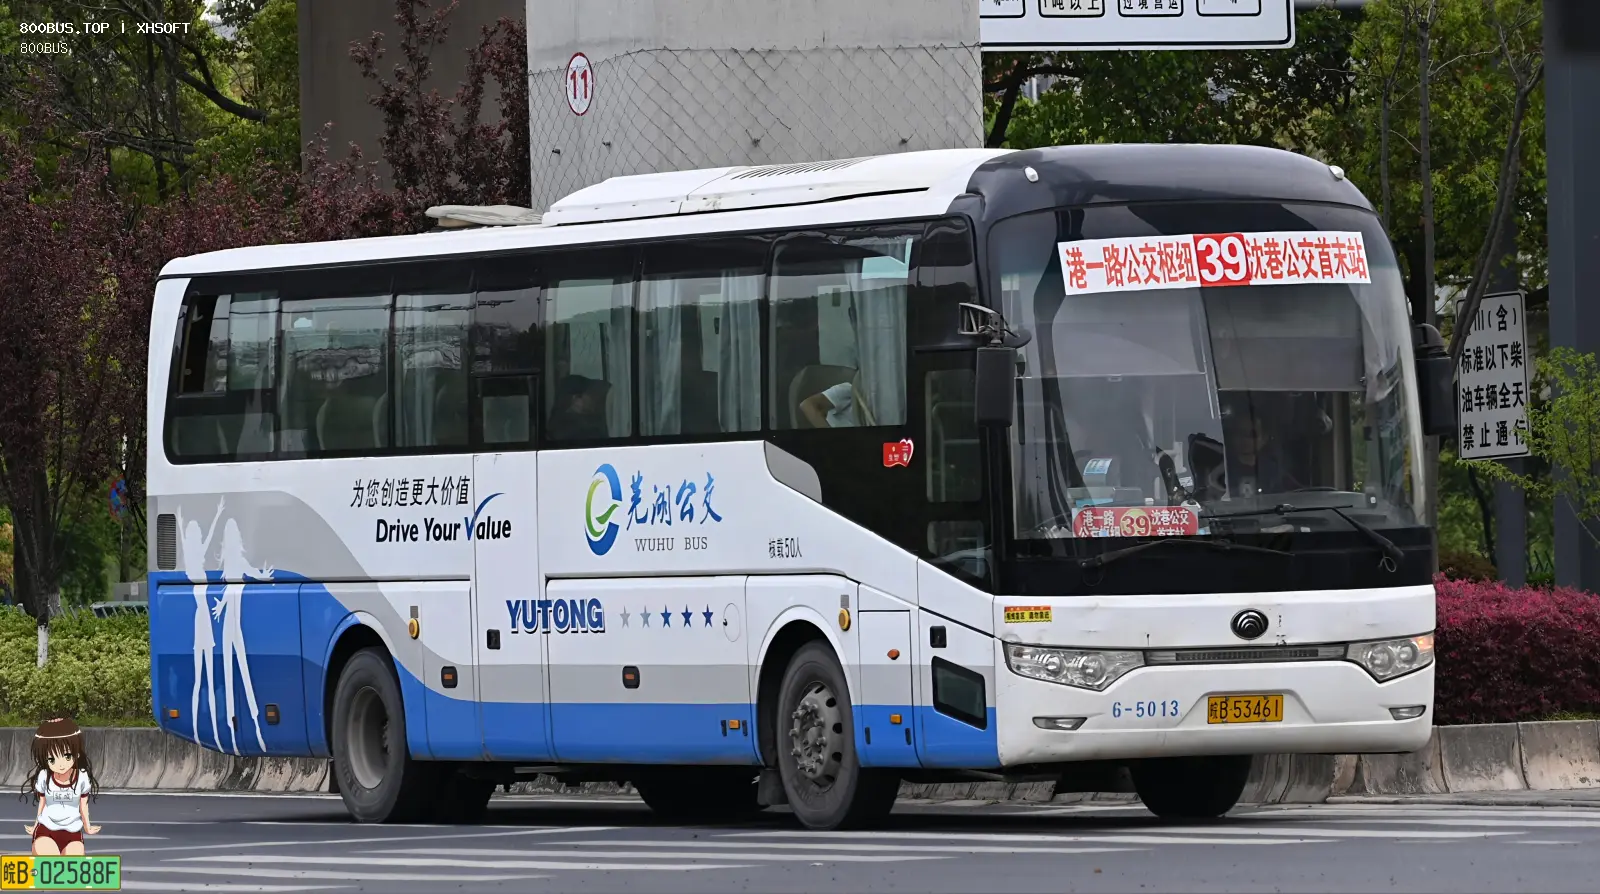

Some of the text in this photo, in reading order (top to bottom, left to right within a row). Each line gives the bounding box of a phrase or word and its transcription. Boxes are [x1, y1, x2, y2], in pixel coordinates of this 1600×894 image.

[570, 69, 588, 100] 11
[1066, 235, 1368, 289] 港一路公交枢纽 39 沈巷公交首末站
[1461, 341, 1523, 374] 标准以下柴
[1462, 382, 1524, 413] 油车辆全天
[350, 475, 471, 508] 为您创造更大价值
[626, 470, 723, 531] 芜湖公交
[375, 497, 512, 542] Drive Your Value
[1083, 510, 1115, 527] 港一路
[1121, 515, 1150, 537] 39
[1151, 509, 1190, 525] 沈巷公交
[635, 536, 708, 552] WUHU BUS
[506, 597, 606, 634] YUTONG
[1112, 699, 1179, 718] 6-5013
